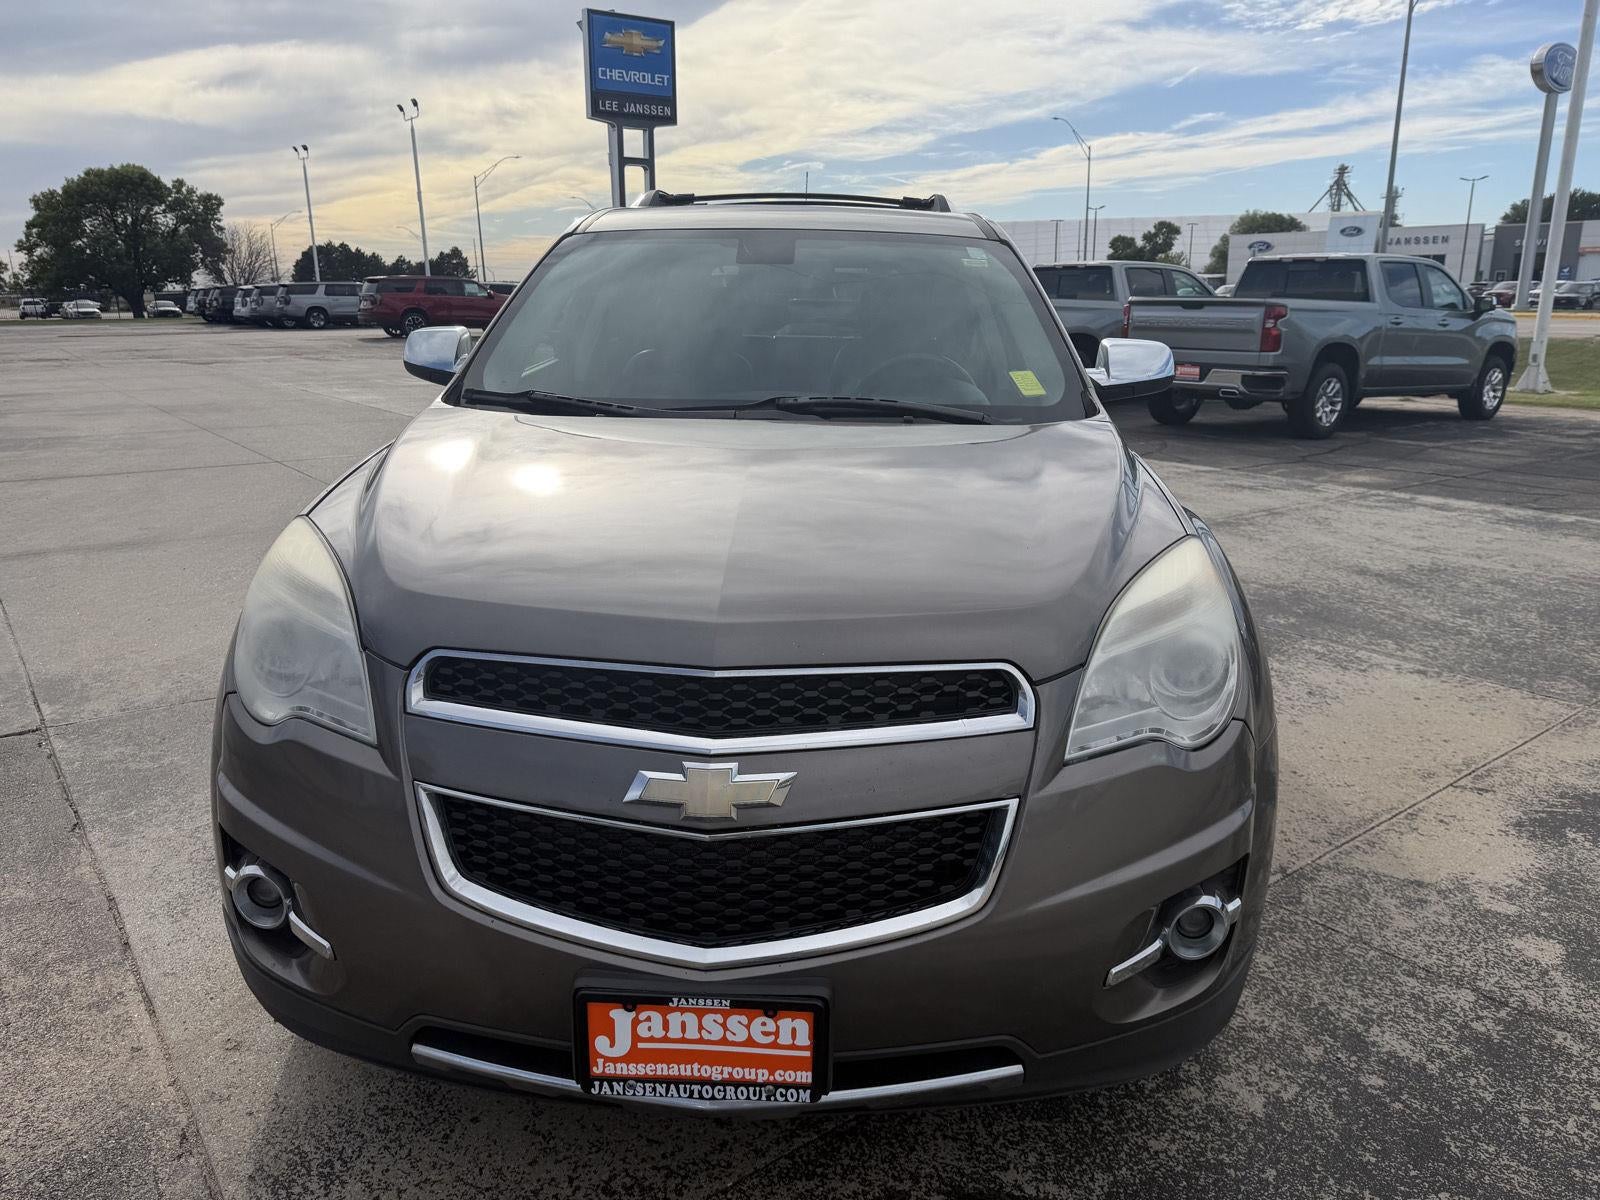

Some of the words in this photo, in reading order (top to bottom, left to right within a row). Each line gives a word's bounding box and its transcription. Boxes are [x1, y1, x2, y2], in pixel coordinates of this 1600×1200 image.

[598, 67, 670, 87] CHEVROLET
[599, 100, 619, 111] LEE
[623, 101, 671, 116] JANSSEN
[1387, 235, 1450, 246] JANSSEN
[669, 997, 730, 1009] JANSSEN
[594, 1008, 811, 1058] Janssen
[592, 1058, 813, 1084] Janssenautogroup.com
